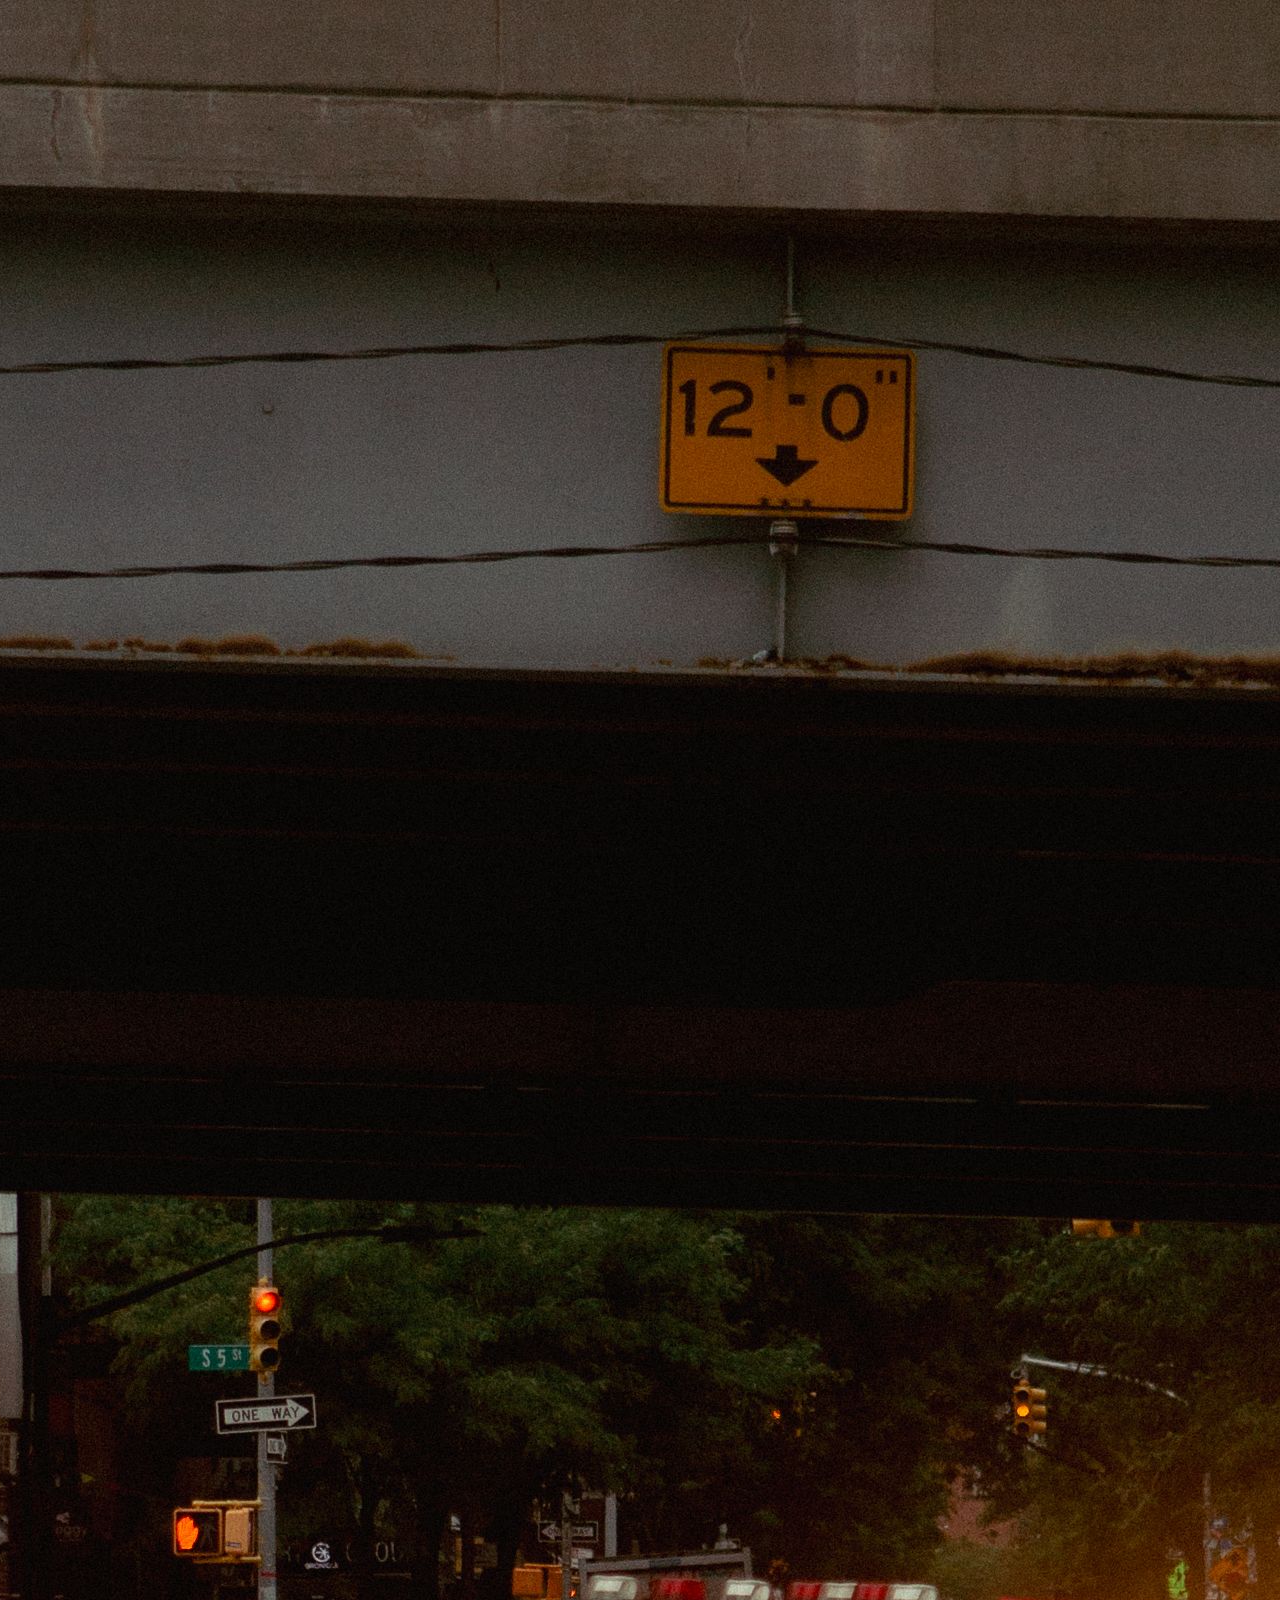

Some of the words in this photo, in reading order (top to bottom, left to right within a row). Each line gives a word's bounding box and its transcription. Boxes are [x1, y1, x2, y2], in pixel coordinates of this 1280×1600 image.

[202, 1349, 210, 1367] S
[218, 1349, 226, 1367] 5
[232, 1409, 259, 1422] ONE
[272, 1406, 300, 1419] WAY
